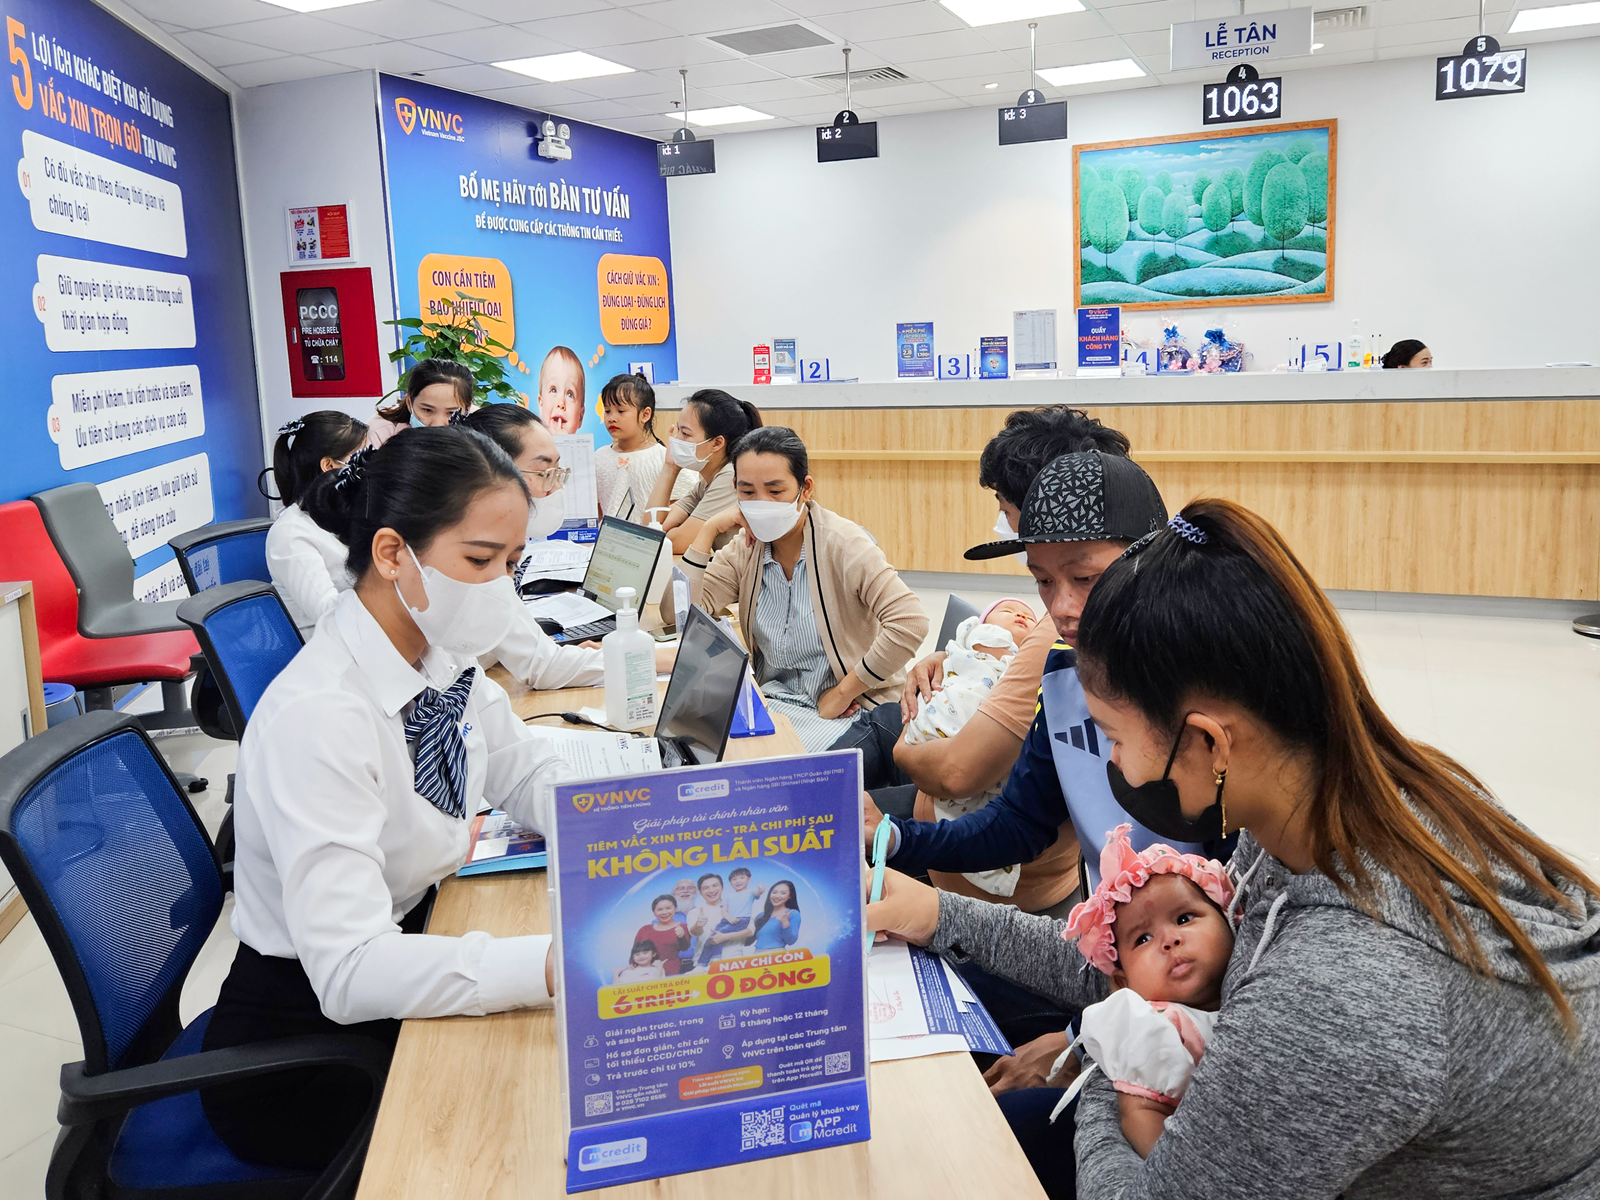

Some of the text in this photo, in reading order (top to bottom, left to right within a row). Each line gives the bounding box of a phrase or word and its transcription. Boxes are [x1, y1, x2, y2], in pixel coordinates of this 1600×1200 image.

[1206, 22, 1276, 48] LỄ TÂN
[1212, 46, 1269, 60] RECEPTION
[1477, 38, 1486, 52] 5
[6, 15, 174, 128] 5 LỢI ÍCH KHÁC BIỆT KHI SỬ DỤNG
[1238, 67, 1246, 79] 4
[1440, 54, 1522, 94] 1079
[1027, 91, 1035, 103] 3
[1206, 82, 1278, 118] 1063
[39, 77, 177, 169] VẮC XIN TRỌN GÓI TẠI VNVC
[417, 106, 463, 134] VNVC
[843, 112, 849, 123] 2
[1004, 109, 1026, 120] id: 3
[680, 129, 686, 141] 1
[821, 128, 842, 140] id: 2
[662, 145, 680, 155] id: 1
[22, 171, 31, 188] 01
[44, 156, 165, 211] Có đủ vắc xin theo đúng thời gian và
[459, 170, 630, 219] BỐ MẸ HÃY TỚI BÀN TƯ VẤN
[49, 194, 90, 225] chủng loại
[475, 211, 623, 242] ĐỂ ĐƯỢC CUNG CẤP CÁC THÔNG TIN CẦN THIẾT:
[432, 268, 496, 288] CON CẦN TIÊM
[607, 269, 622, 284] CÁCH
[623, 271, 633, 285] GIỮ
[635, 270, 646, 285] VẮC
[603, 292, 666, 311] ĐÚNG LOẠI ĐÚNG LỊCH
[300, 305, 338, 320] PCCC
[621, 316, 638, 330] ĐÚNG
[1101, 334, 1118, 342] HÀNG
[1315, 345, 1329, 362] 5
[809, 361, 822, 378] 2
[947, 357, 960, 375] 3
[595, 787, 651, 805] VNVC
[633, 805, 789, 834] Giải pháp tài chính nhân văn
[587, 814, 833, 852] TIÊM VẮC XIN TRƯỚC TRẢ CHI PHÍ SAU
[588, 825, 834, 879] KHÔNG LÃI SUẤT
[719, 951, 804, 971] NAY CHỈ CÒN
[740, 968, 816, 993] ĐỒNG
[747, 1017, 771, 1027] tháng
[773, 1015, 793, 1023] hoặc
[805, 1009, 828, 1018] tháng
[605, 1017, 704, 1038] Giải ngân trước, trong
[637, 1032, 657, 1042] buổi
[659, 1030, 680, 1038] tiêm
[742, 1025, 847, 1047] Áp dụng tại các Trung tâm
[742, 1038, 825, 1058] VNVC trên toàn quốc
[789, 1112, 810, 1121] Quản
[812, 1110, 819, 1118] lý
[821, 1107, 844, 1115] khoản
[790, 1100, 821, 1111] Quét mã
[814, 1116, 841, 1129] APP
[814, 1123, 857, 1139] Mcredit
[586, 1143, 641, 1162] mcredit
